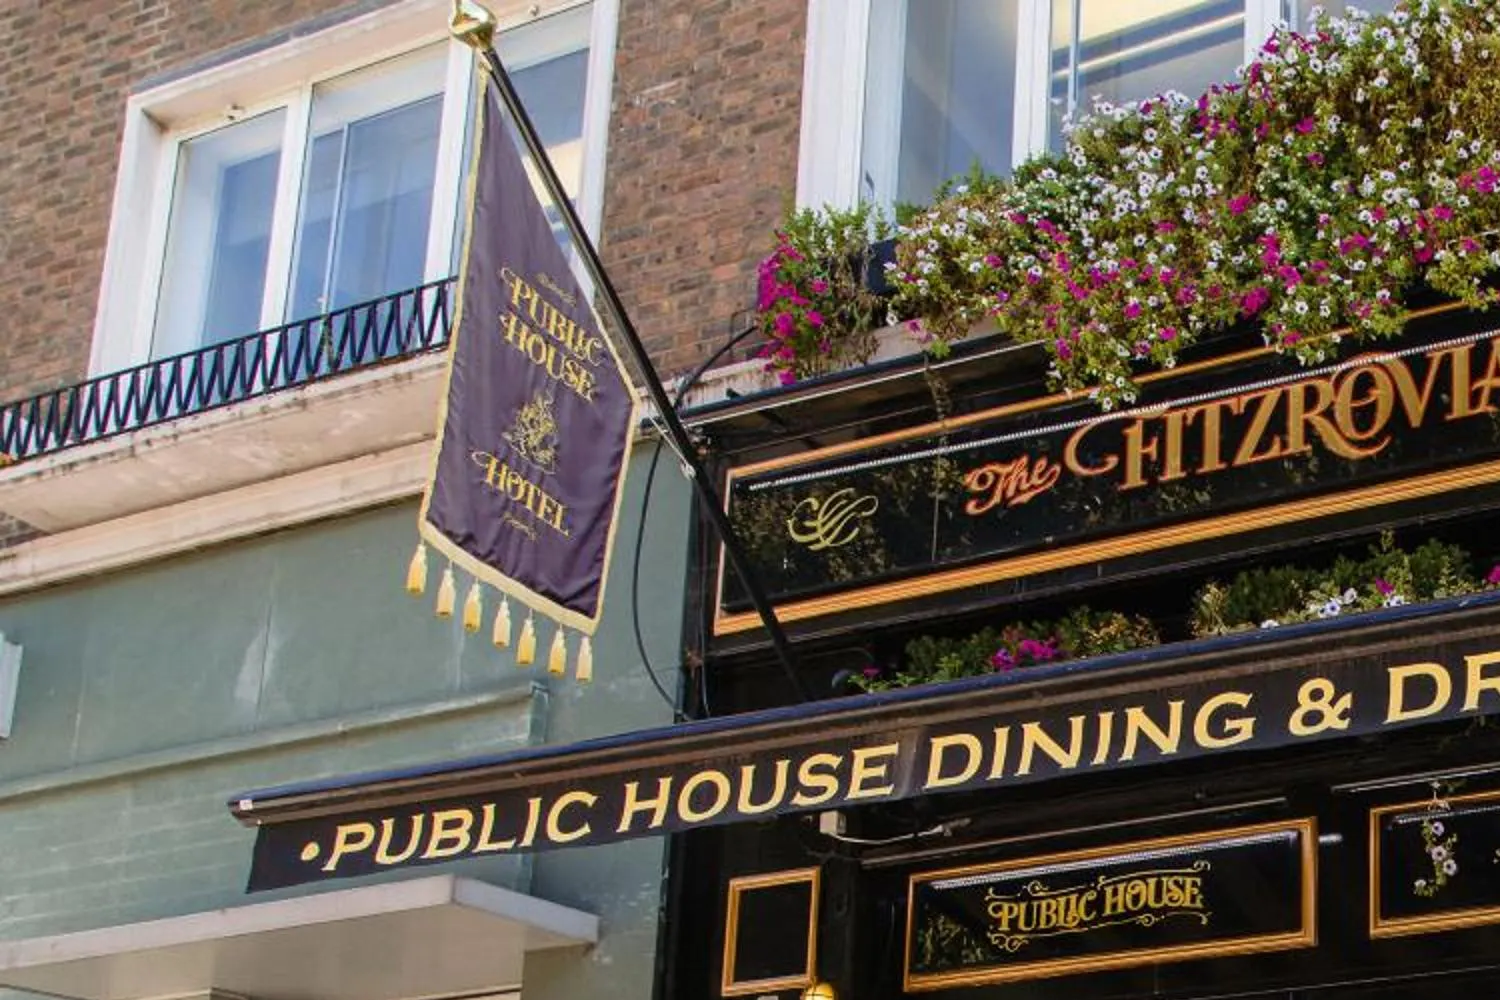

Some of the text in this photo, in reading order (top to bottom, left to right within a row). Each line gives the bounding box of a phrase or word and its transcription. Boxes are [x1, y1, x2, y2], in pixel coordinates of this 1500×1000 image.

[499, 311, 594, 402] HOUSE
[501, 267, 606, 367] PUBLIC
[471, 451, 571, 537] HOTEL
[964, 456, 1061, 516] The
[321, 790, 598, 872] PUBLIC
[617, 741, 902, 834] HOUSE
[922, 691, 1258, 791] DINING
[1288, 677, 1352, 737] &
[987, 875, 1205, 932] PUBLIC HOUSE
